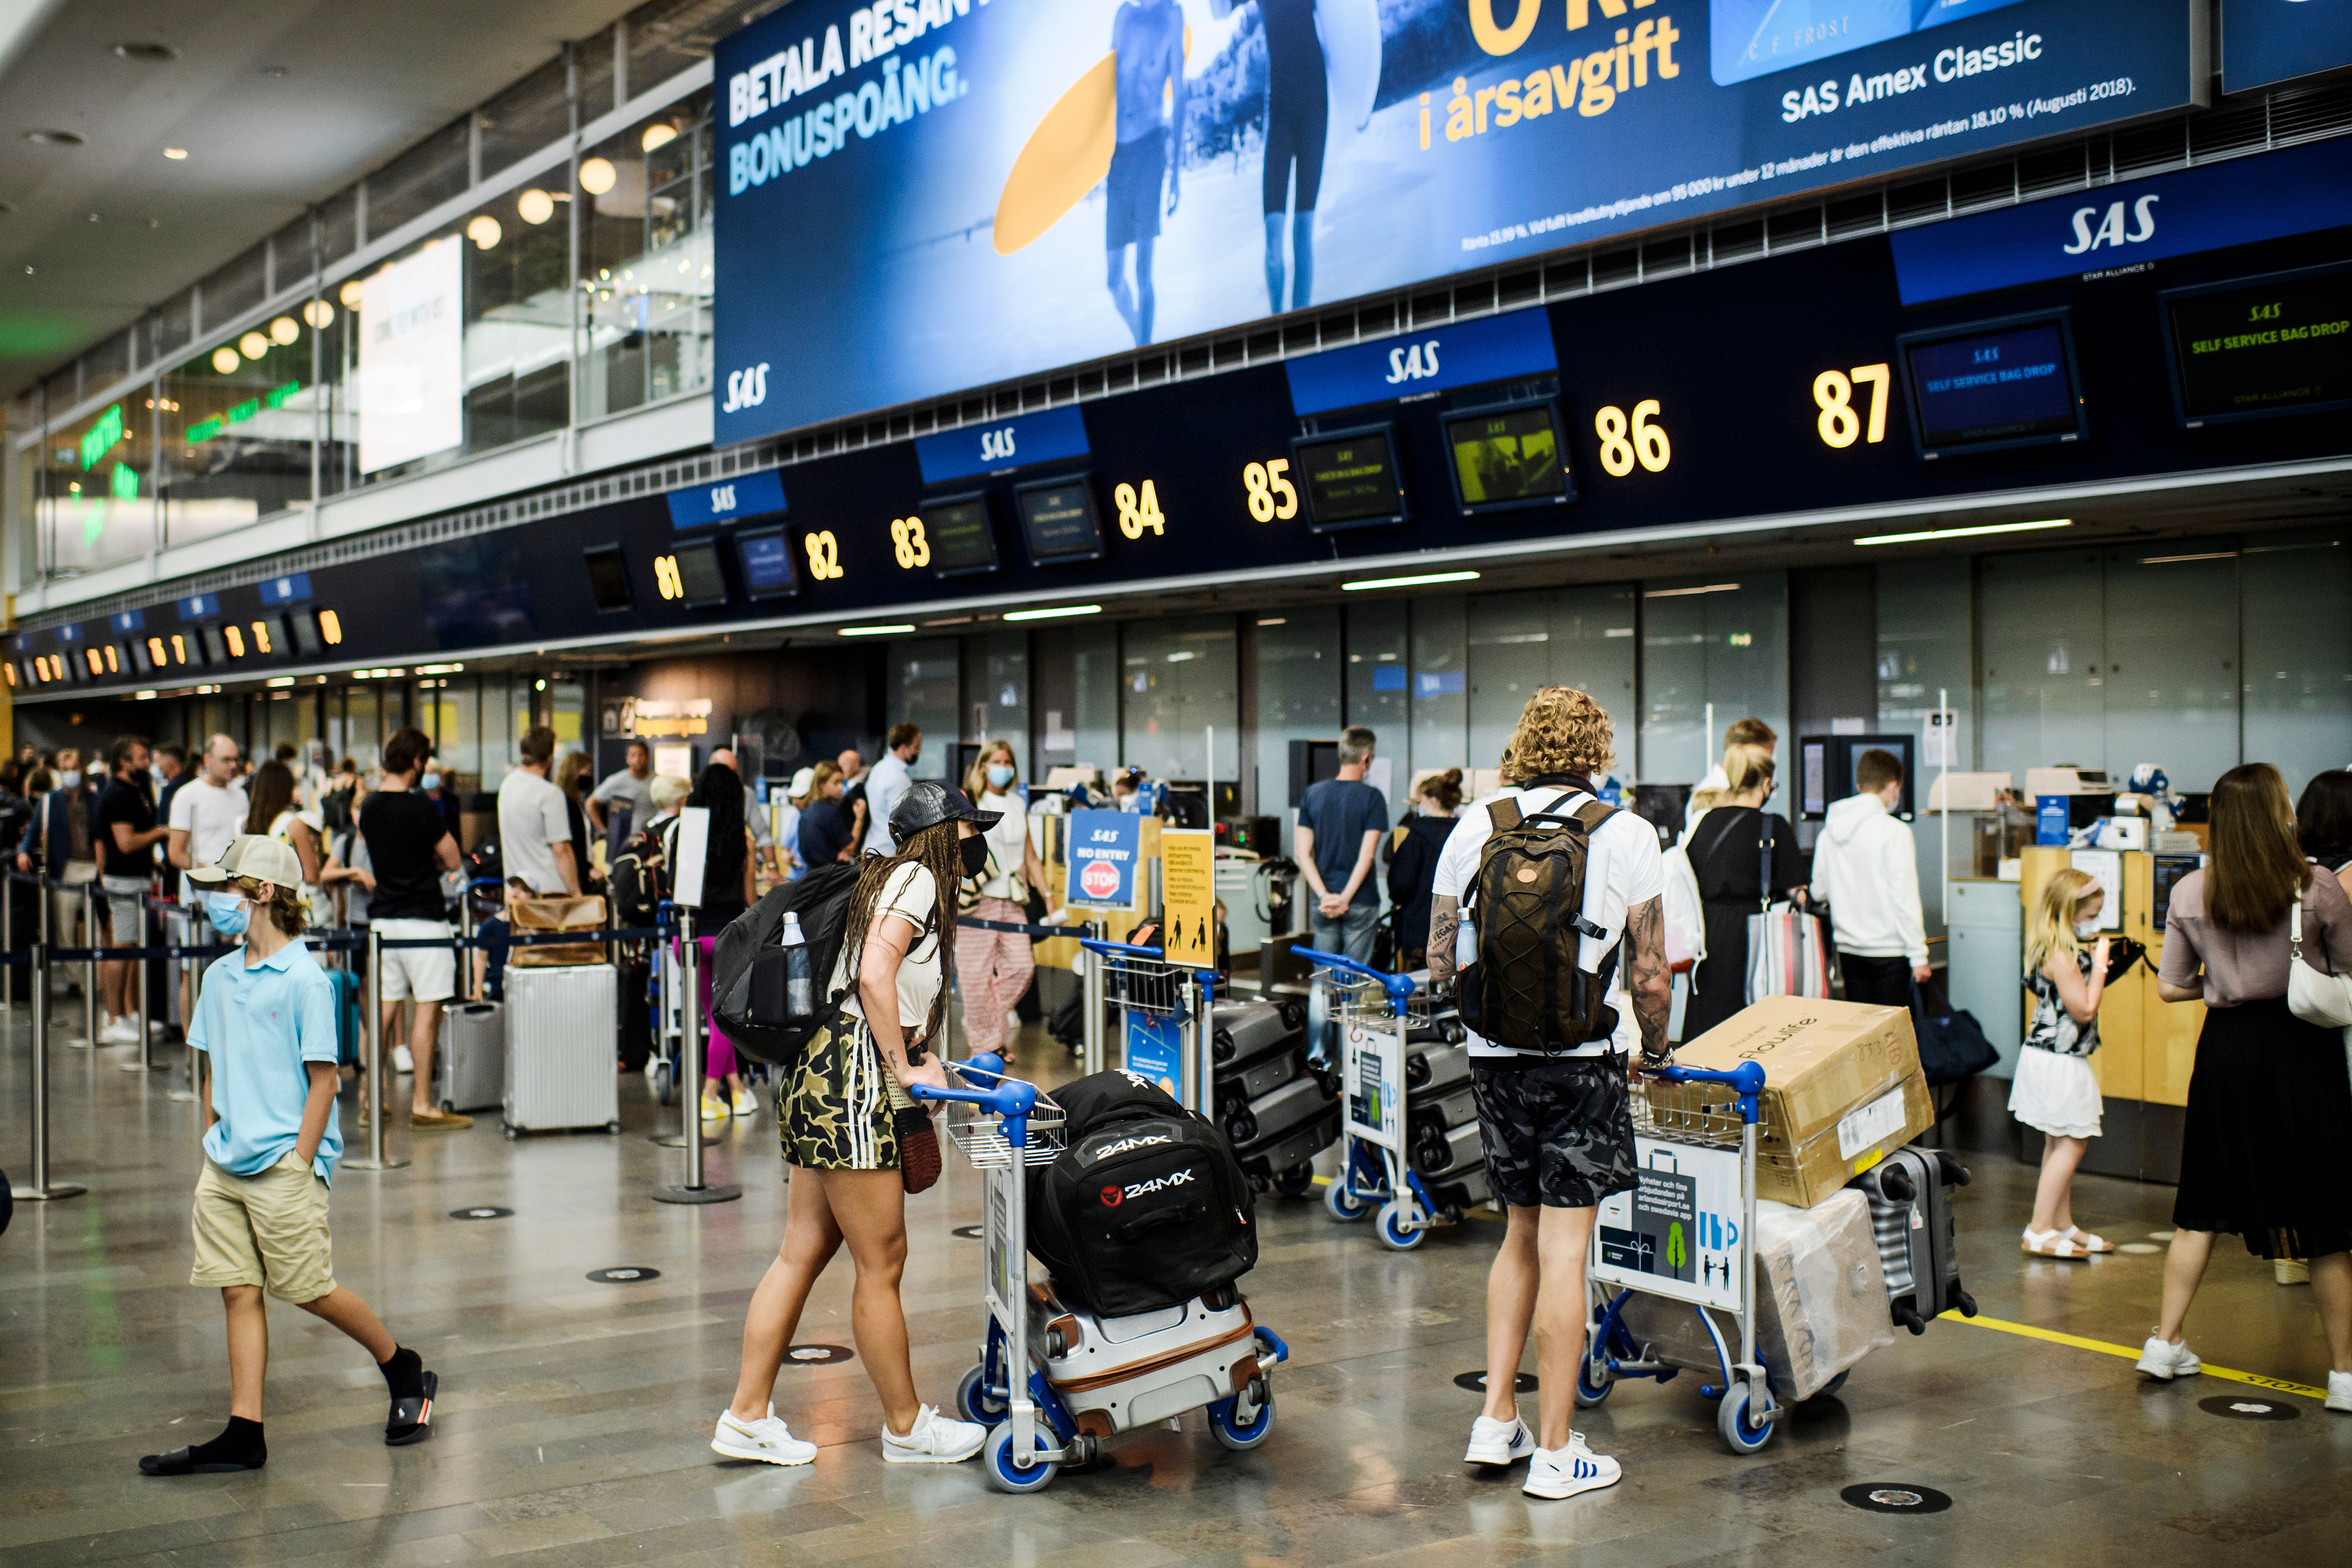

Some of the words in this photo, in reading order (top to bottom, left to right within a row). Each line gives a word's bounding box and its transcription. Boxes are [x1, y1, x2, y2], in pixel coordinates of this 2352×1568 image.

[1772, 37, 1780, 55] F
[1794, 16, 1849, 48] FROST
[729, 24, 846, 127] BETALA
[1420, 93, 1430, 150] i
[1446, 16, 1679, 142] årsavgift
[1781, 80, 1839, 124] SAS
[1846, 63, 1927, 108] Amex
[1933, 30, 2043, 83] Classic
[729, 46, 970, 195] BONUSPOÄNG.
[1760, 162, 1776, 180] 12
[1775, 151, 1830, 176] månader
[1844, 141, 1869, 159] den
[1870, 128, 1923, 154] effektiva
[1925, 116, 1970, 140] räntan
[1970, 107, 2007, 129] 18,10
[2008, 104, 2024, 120] %
[2027, 88, 2087, 119] (Augusti
[2089, 77, 2137, 102] 2018).
[2062, 194, 2160, 255] SAS
[2105, 263, 2145, 278] ALLIANCE
[2248, 302, 2282, 322] SAS
[2192, 338, 2222, 354] SELF
[2223, 330, 2279, 350] SERVICE
[2281, 326, 2308, 342] BAG
[2310, 320, 2350, 337] DROP
[1386, 340, 1440, 384] SAS
[723, 363, 769, 413] SAS
[1813, 363, 1890, 448] 87
[980, 427, 1016, 462] SAS
[1595, 399, 1671, 477] 86
[710, 485, 737, 513] SAS
[1114, 479, 1165, 540] 84
[1243, 458, 1298, 523] 85
[805, 530, 843, 580] 82
[890, 516, 930, 569] 83
[654, 555, 684, 600] 81
[1077, 847, 1094, 859] NO
[1094, 848, 1130, 861] ENTRY
[1090, 829, 1119, 843] SAS
[1085, 871, 1117, 887] STOP
[1432, 922, 1456, 942] VEGAS
[1738, 1018, 1818, 1059] Flowlife
[1096, 1135, 1172, 1161] 24MX
[1124, 1169, 1195, 1200] 24MX
[1679, 1212, 1692, 1221] app
[2240, 1376, 2313, 1391] STOP
